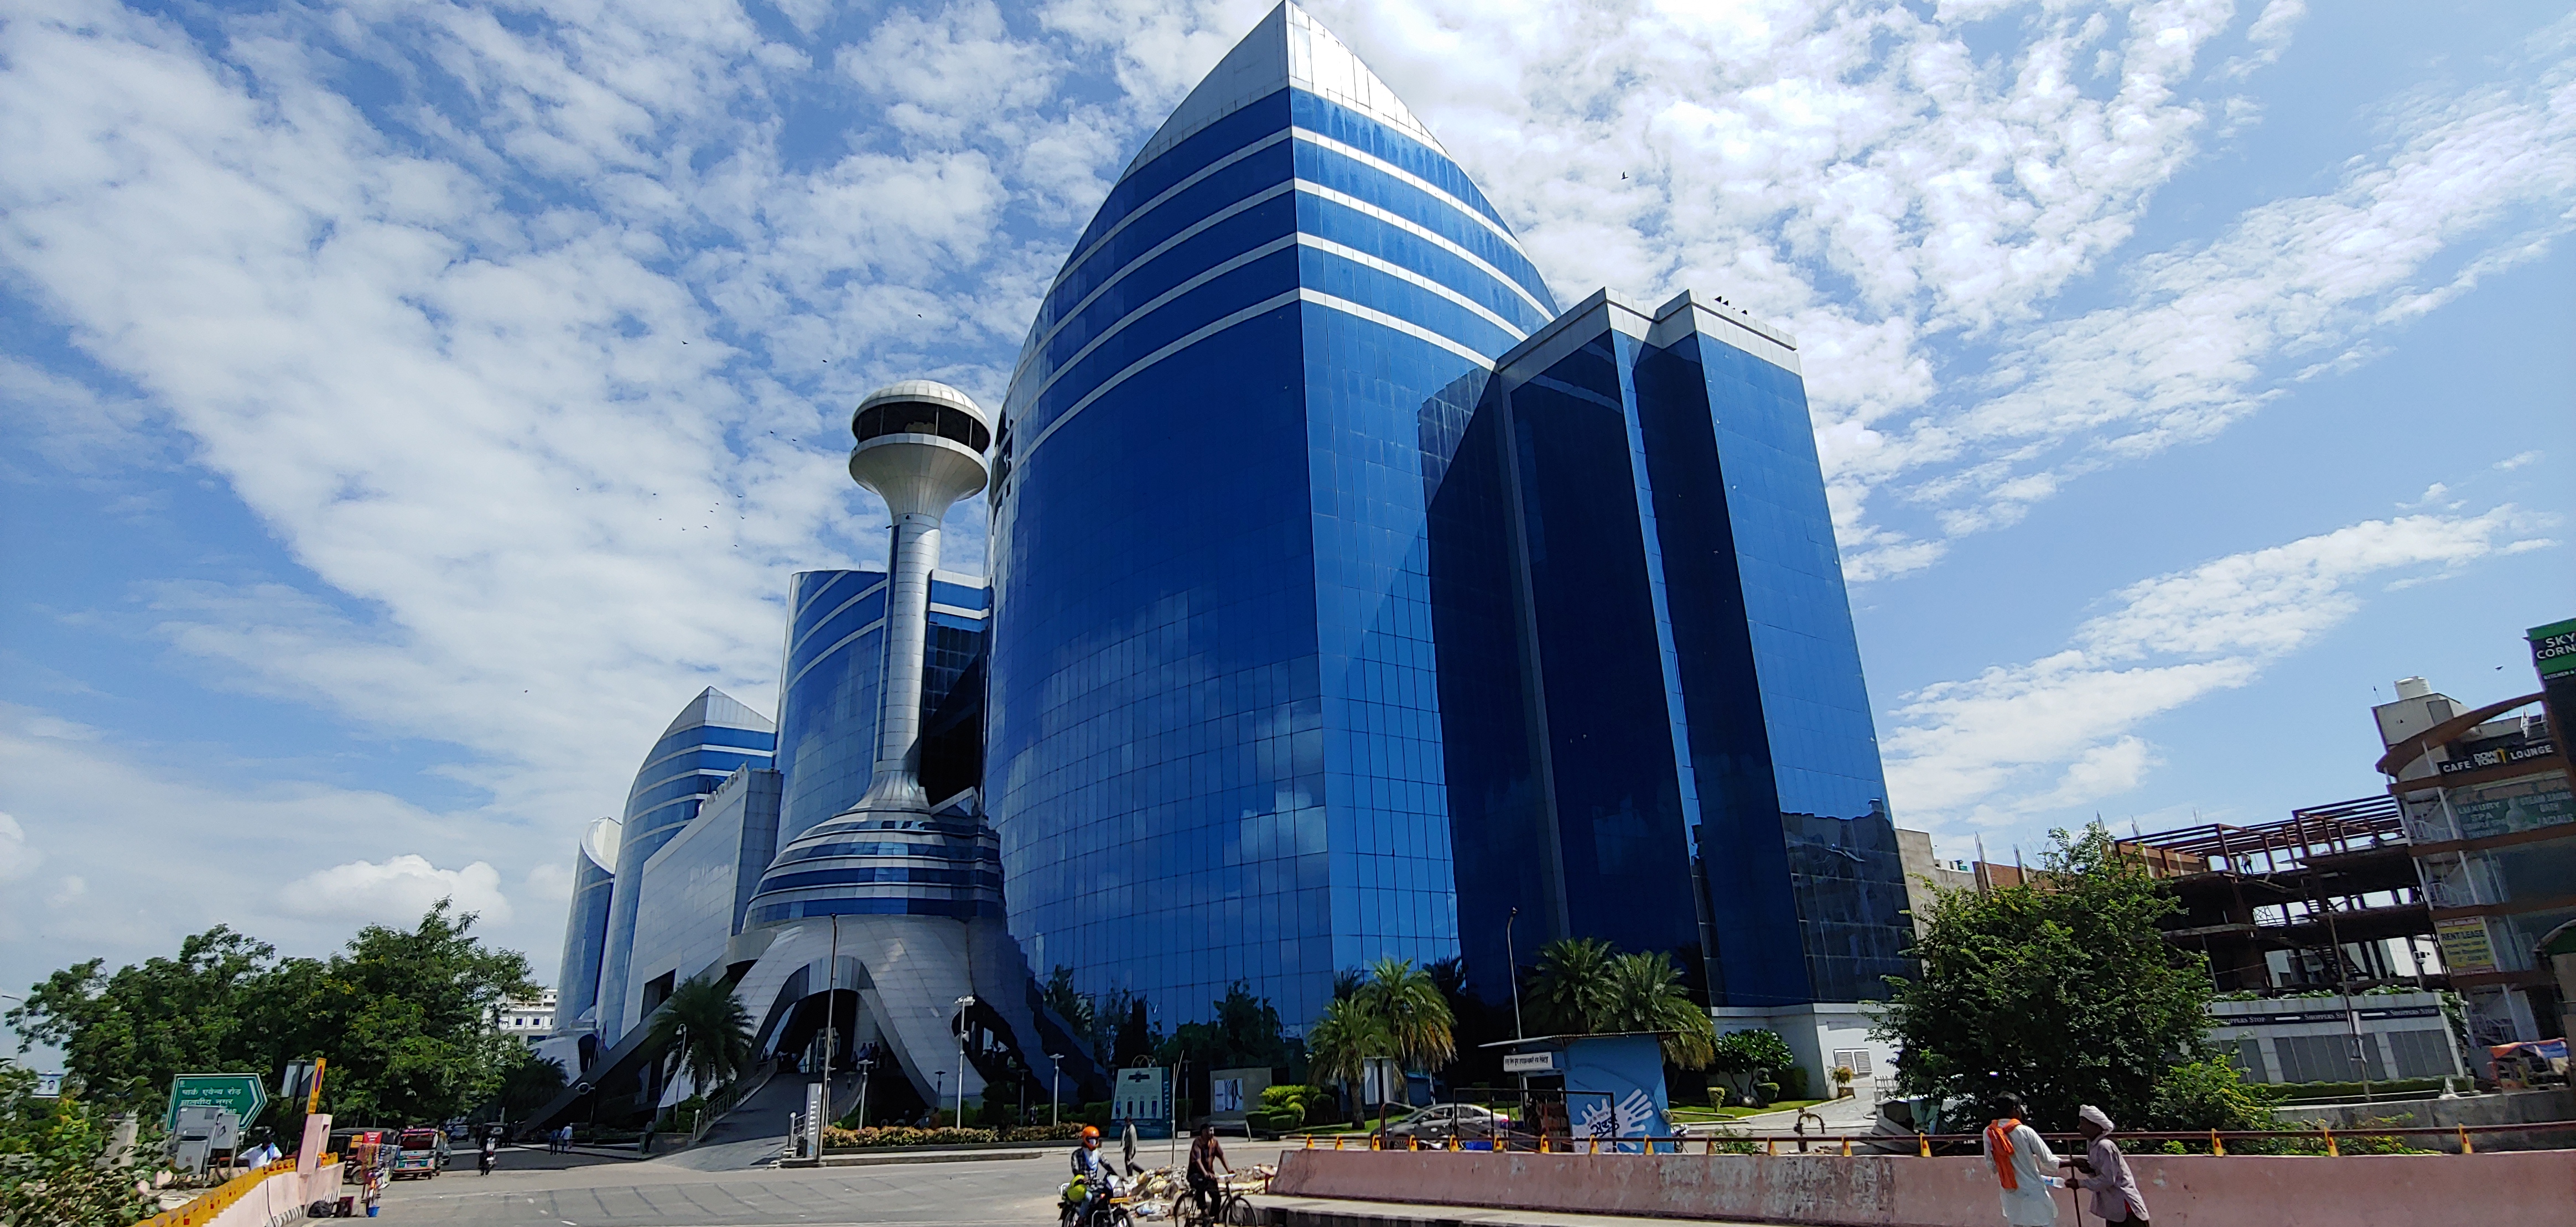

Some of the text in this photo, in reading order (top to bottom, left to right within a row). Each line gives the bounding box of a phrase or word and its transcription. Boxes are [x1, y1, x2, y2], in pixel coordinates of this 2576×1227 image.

[2546, 633, 2575, 647] SKY
[2443, 761, 2472, 773] CAFE
[2510, 745, 2554, 760] LOUNGE
[2457, 802, 2500, 814] LUXURY
